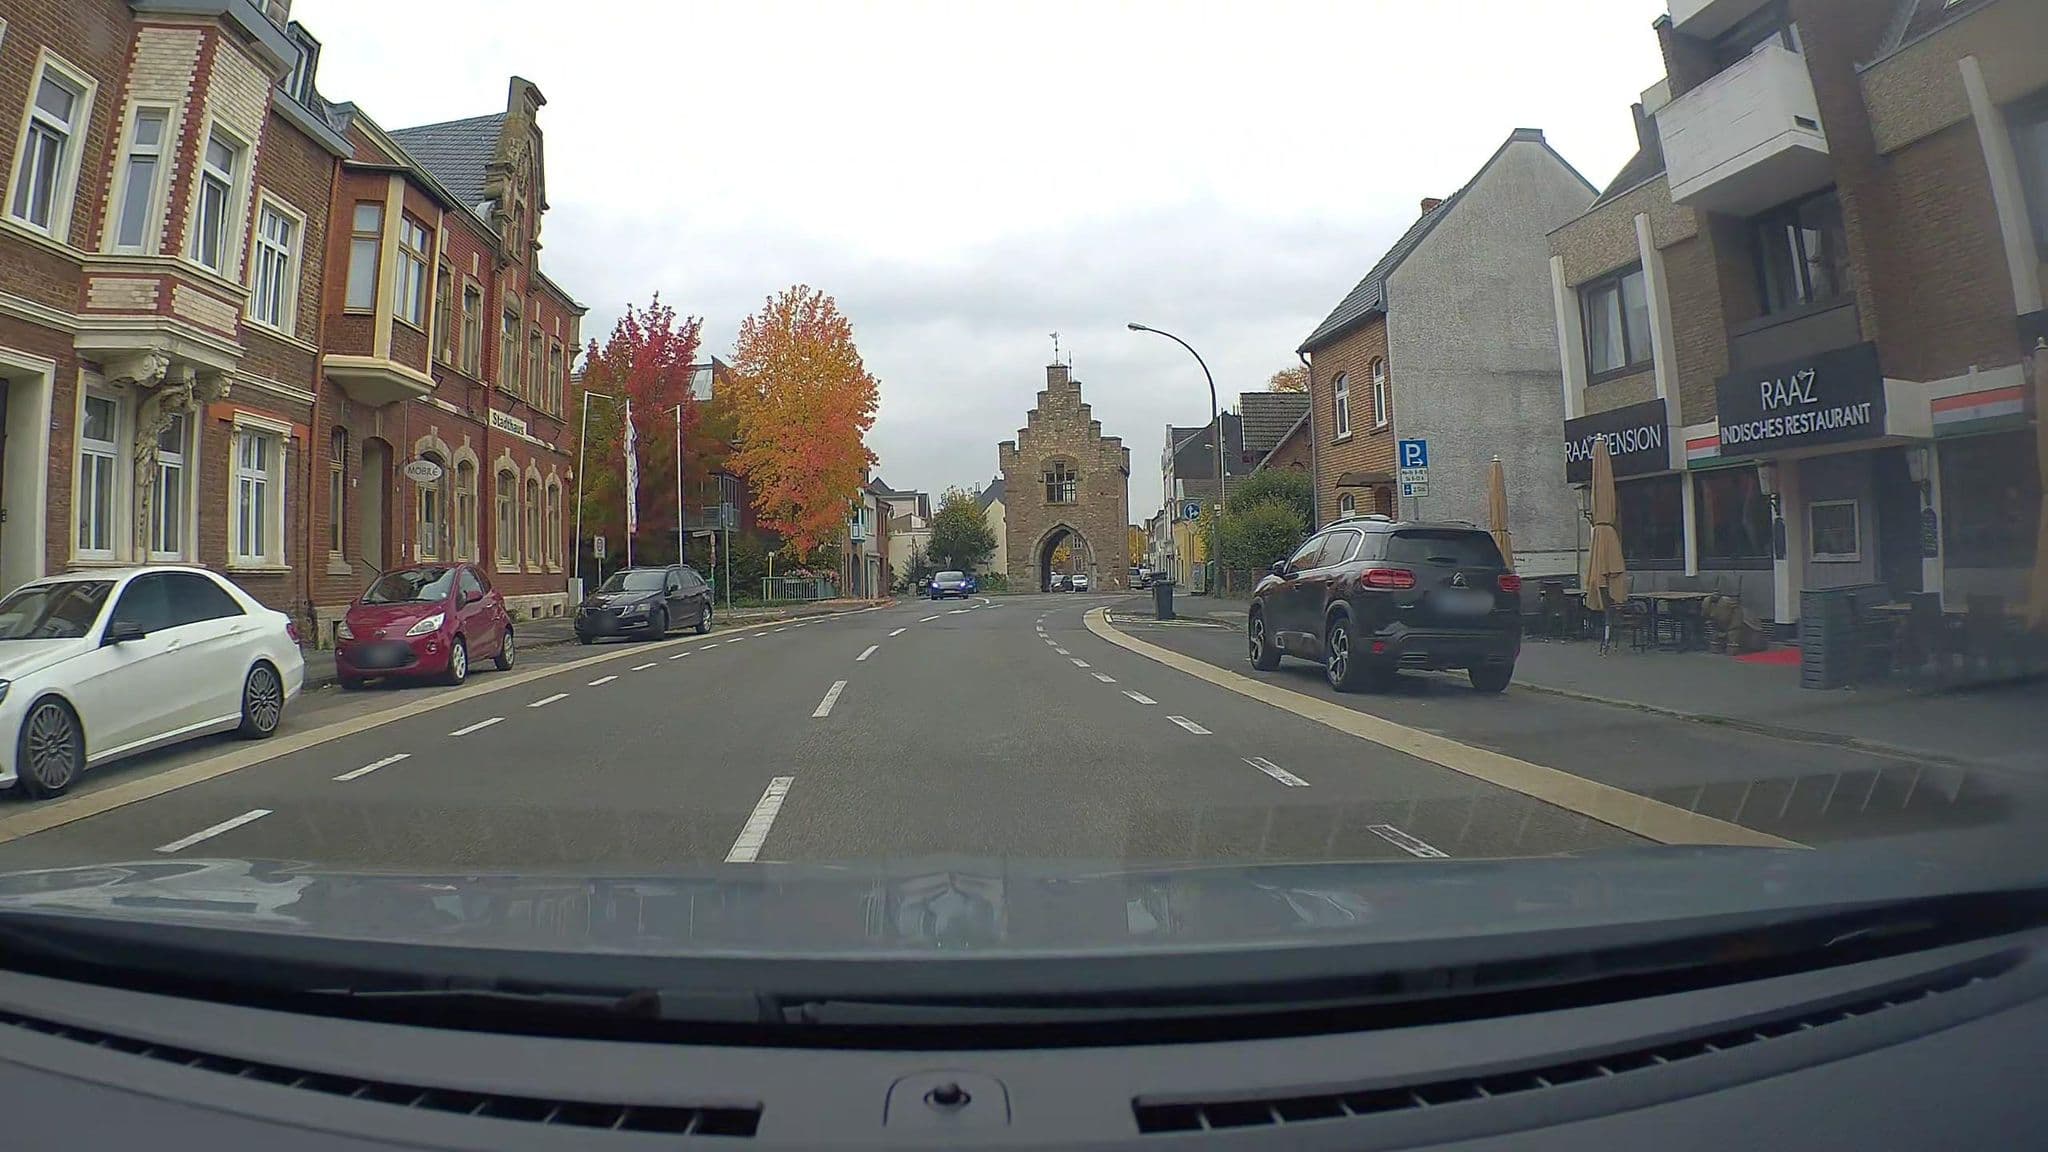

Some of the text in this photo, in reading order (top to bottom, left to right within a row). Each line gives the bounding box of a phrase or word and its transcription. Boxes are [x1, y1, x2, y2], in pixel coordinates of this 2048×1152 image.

[1760, 370, 1818, 411] RAAZ
[1720, 403, 1871, 445] INDISCHES RESTAURANT
[1405, 443, 1421, 467] P
